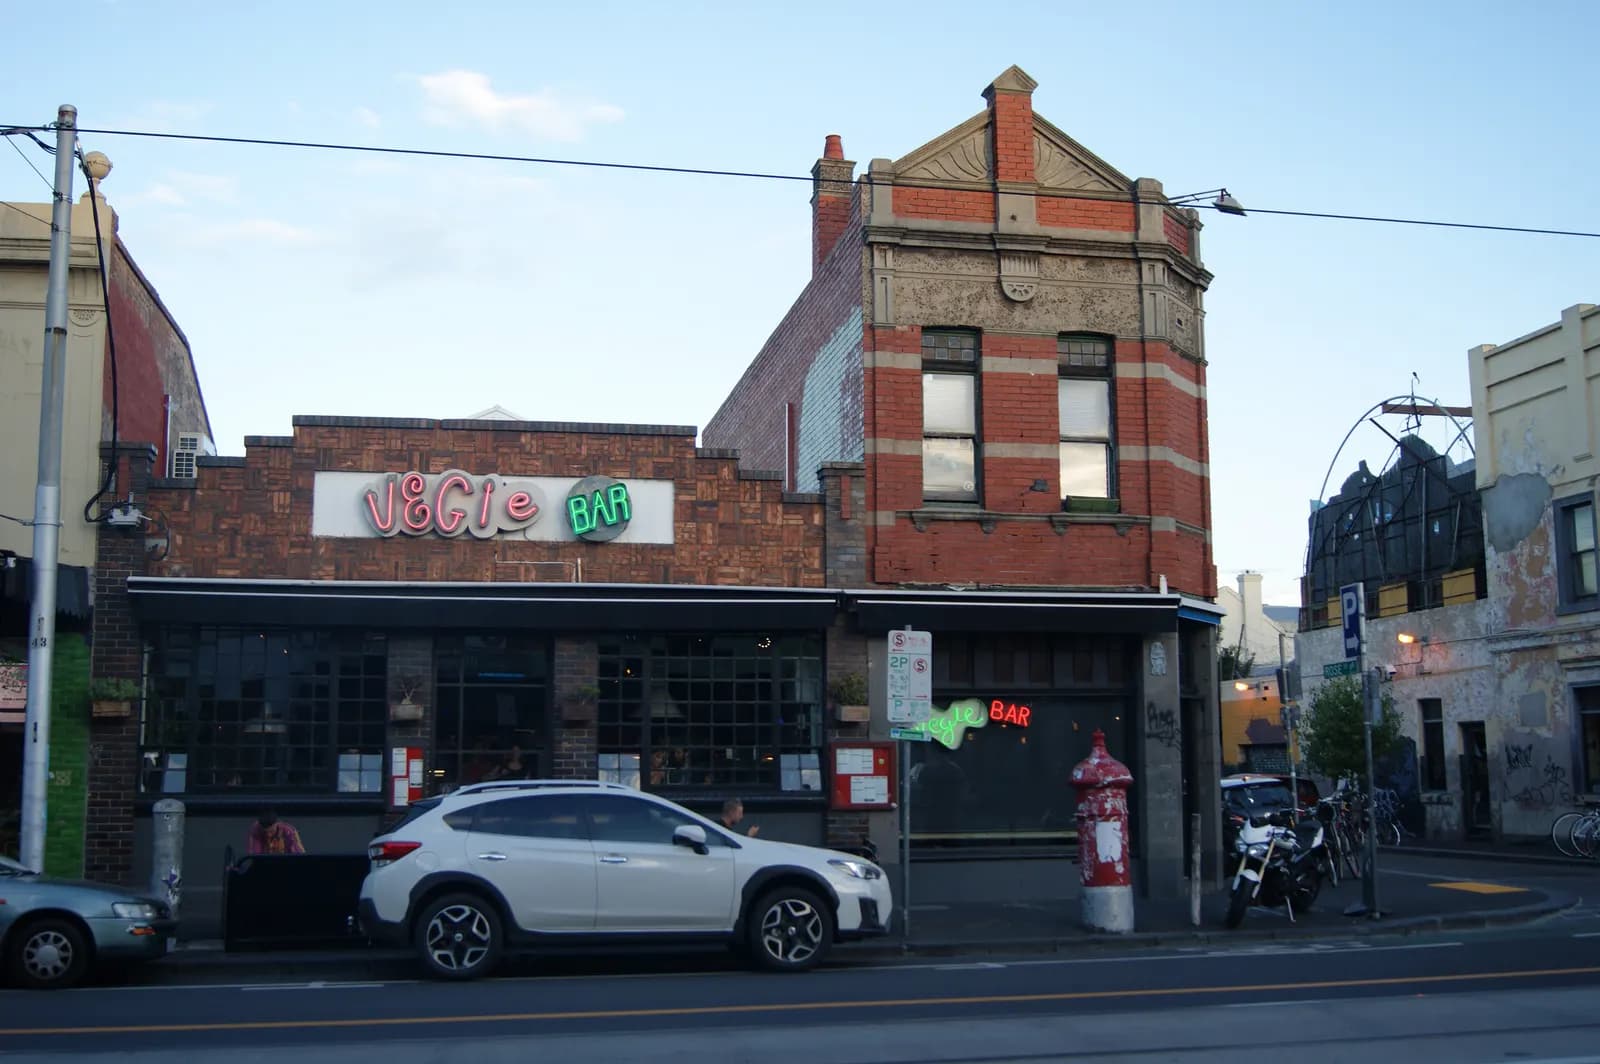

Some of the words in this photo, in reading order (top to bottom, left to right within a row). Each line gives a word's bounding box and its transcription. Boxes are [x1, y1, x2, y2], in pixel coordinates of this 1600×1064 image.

[568, 483, 632, 535] BAR
[1343, 591, 1357, 629] P
[890, 656, 908, 669] 2P
[989, 699, 1031, 728] BAR
